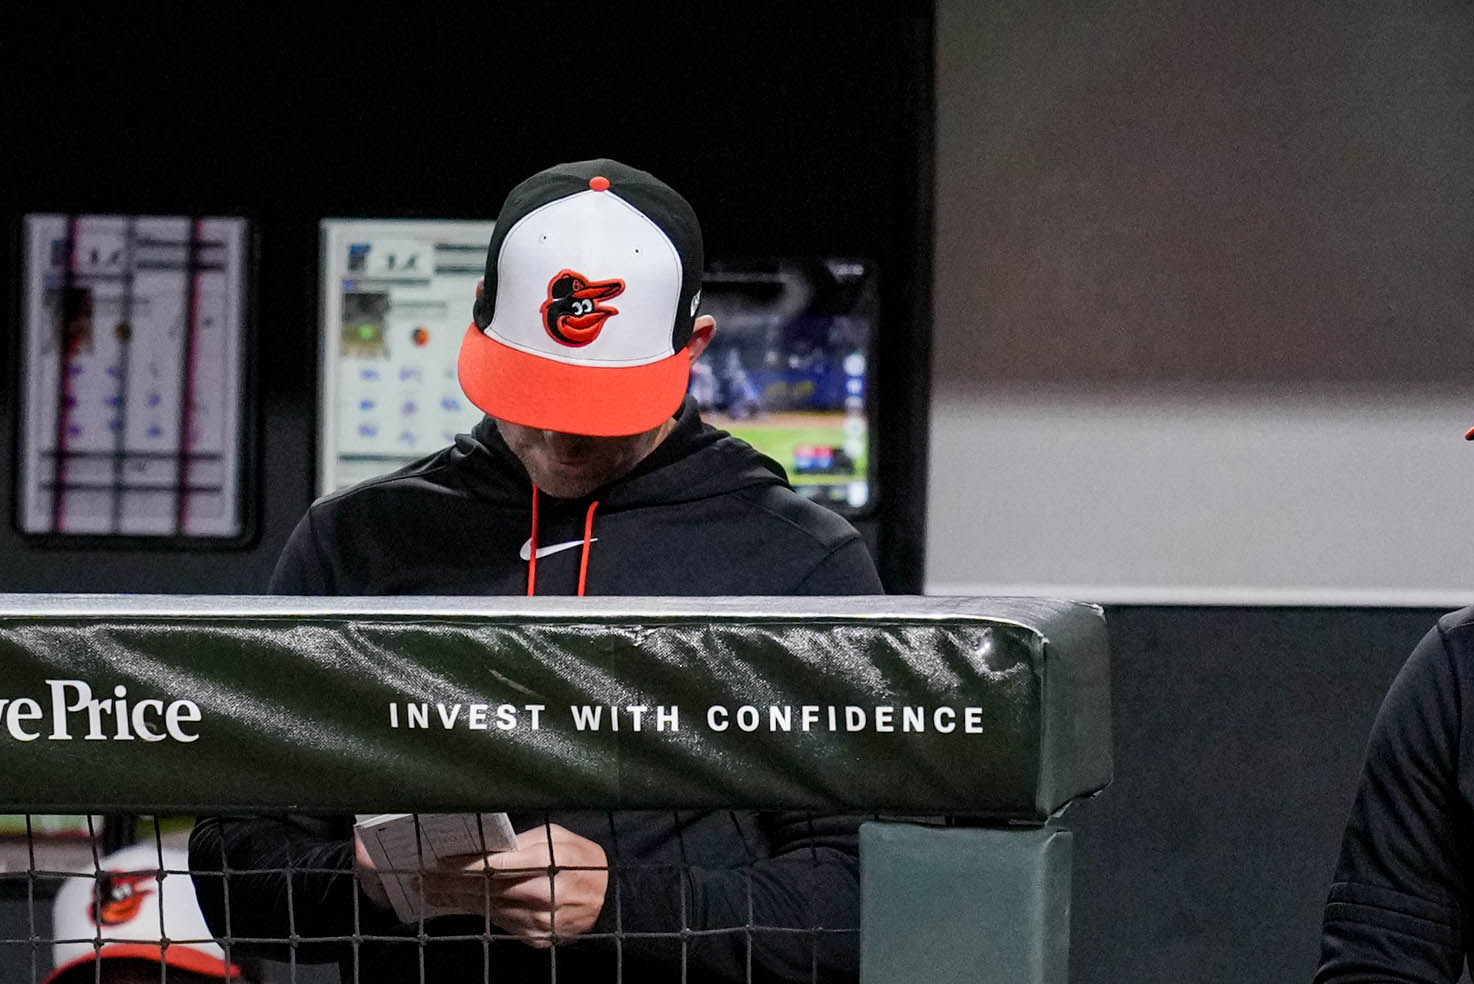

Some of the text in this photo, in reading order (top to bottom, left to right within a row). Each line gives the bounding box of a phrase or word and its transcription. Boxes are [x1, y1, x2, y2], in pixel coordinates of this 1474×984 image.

[0, 679, 202, 743] ePrice
[389, 702, 984, 734] INVEST WITH CONFIDENCE
